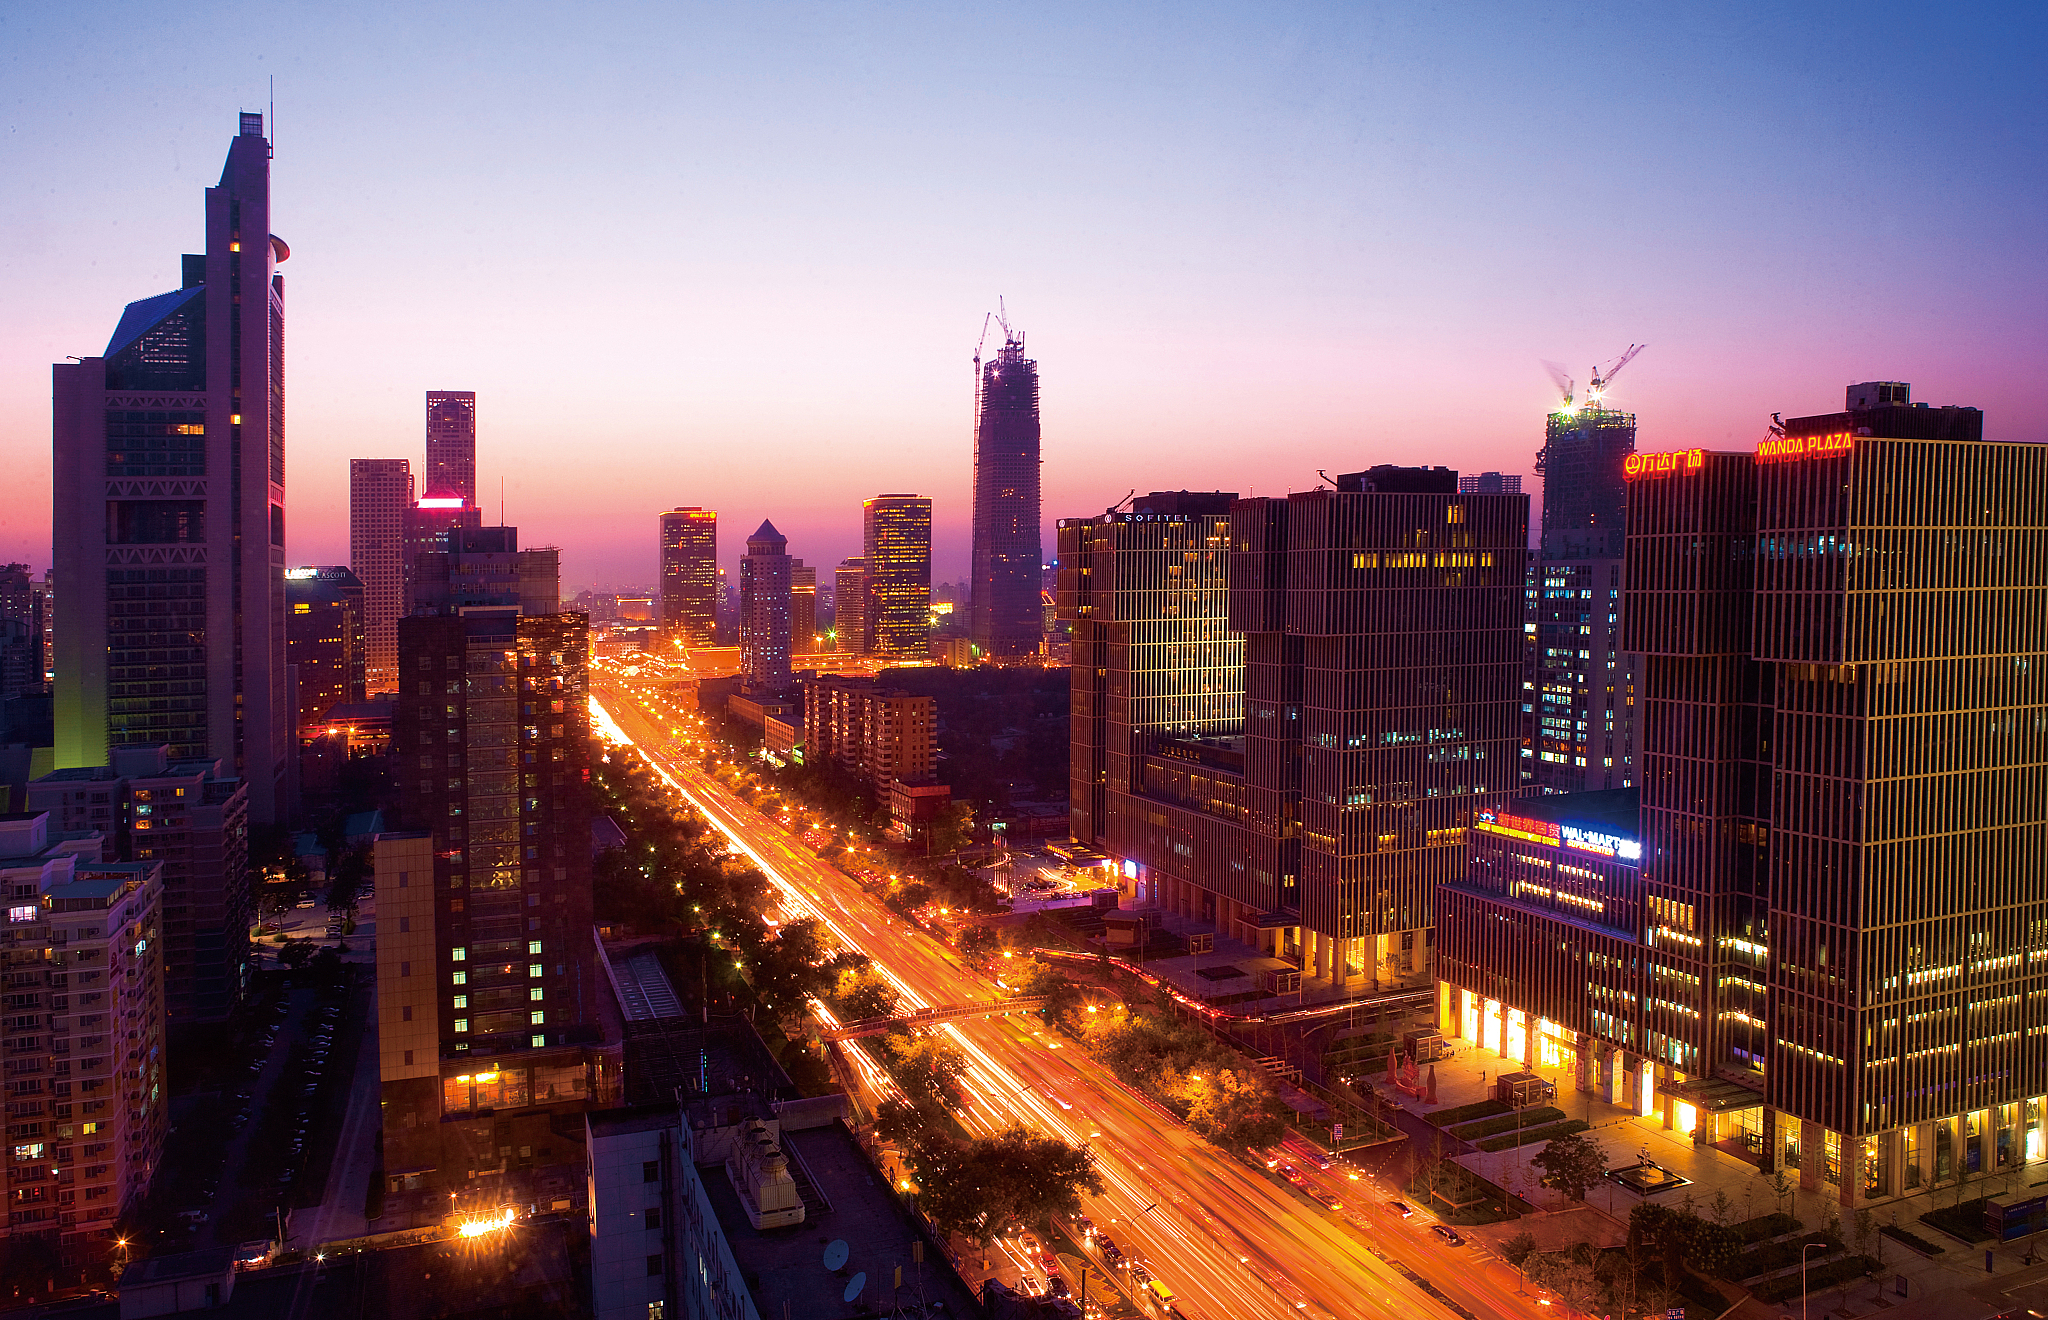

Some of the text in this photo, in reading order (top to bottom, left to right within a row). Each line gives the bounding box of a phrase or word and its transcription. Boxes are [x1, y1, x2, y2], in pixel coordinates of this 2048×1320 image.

[1757, 432, 1853, 457] WANDA PLAZA
[1641, 448, 1703, 473] 万达广场
[1125, 514, 1192, 522] SOFITEL
[1498, 812, 1560, 838] 新世界百货
[1566, 838, 1615, 857] SUPERCENTER
